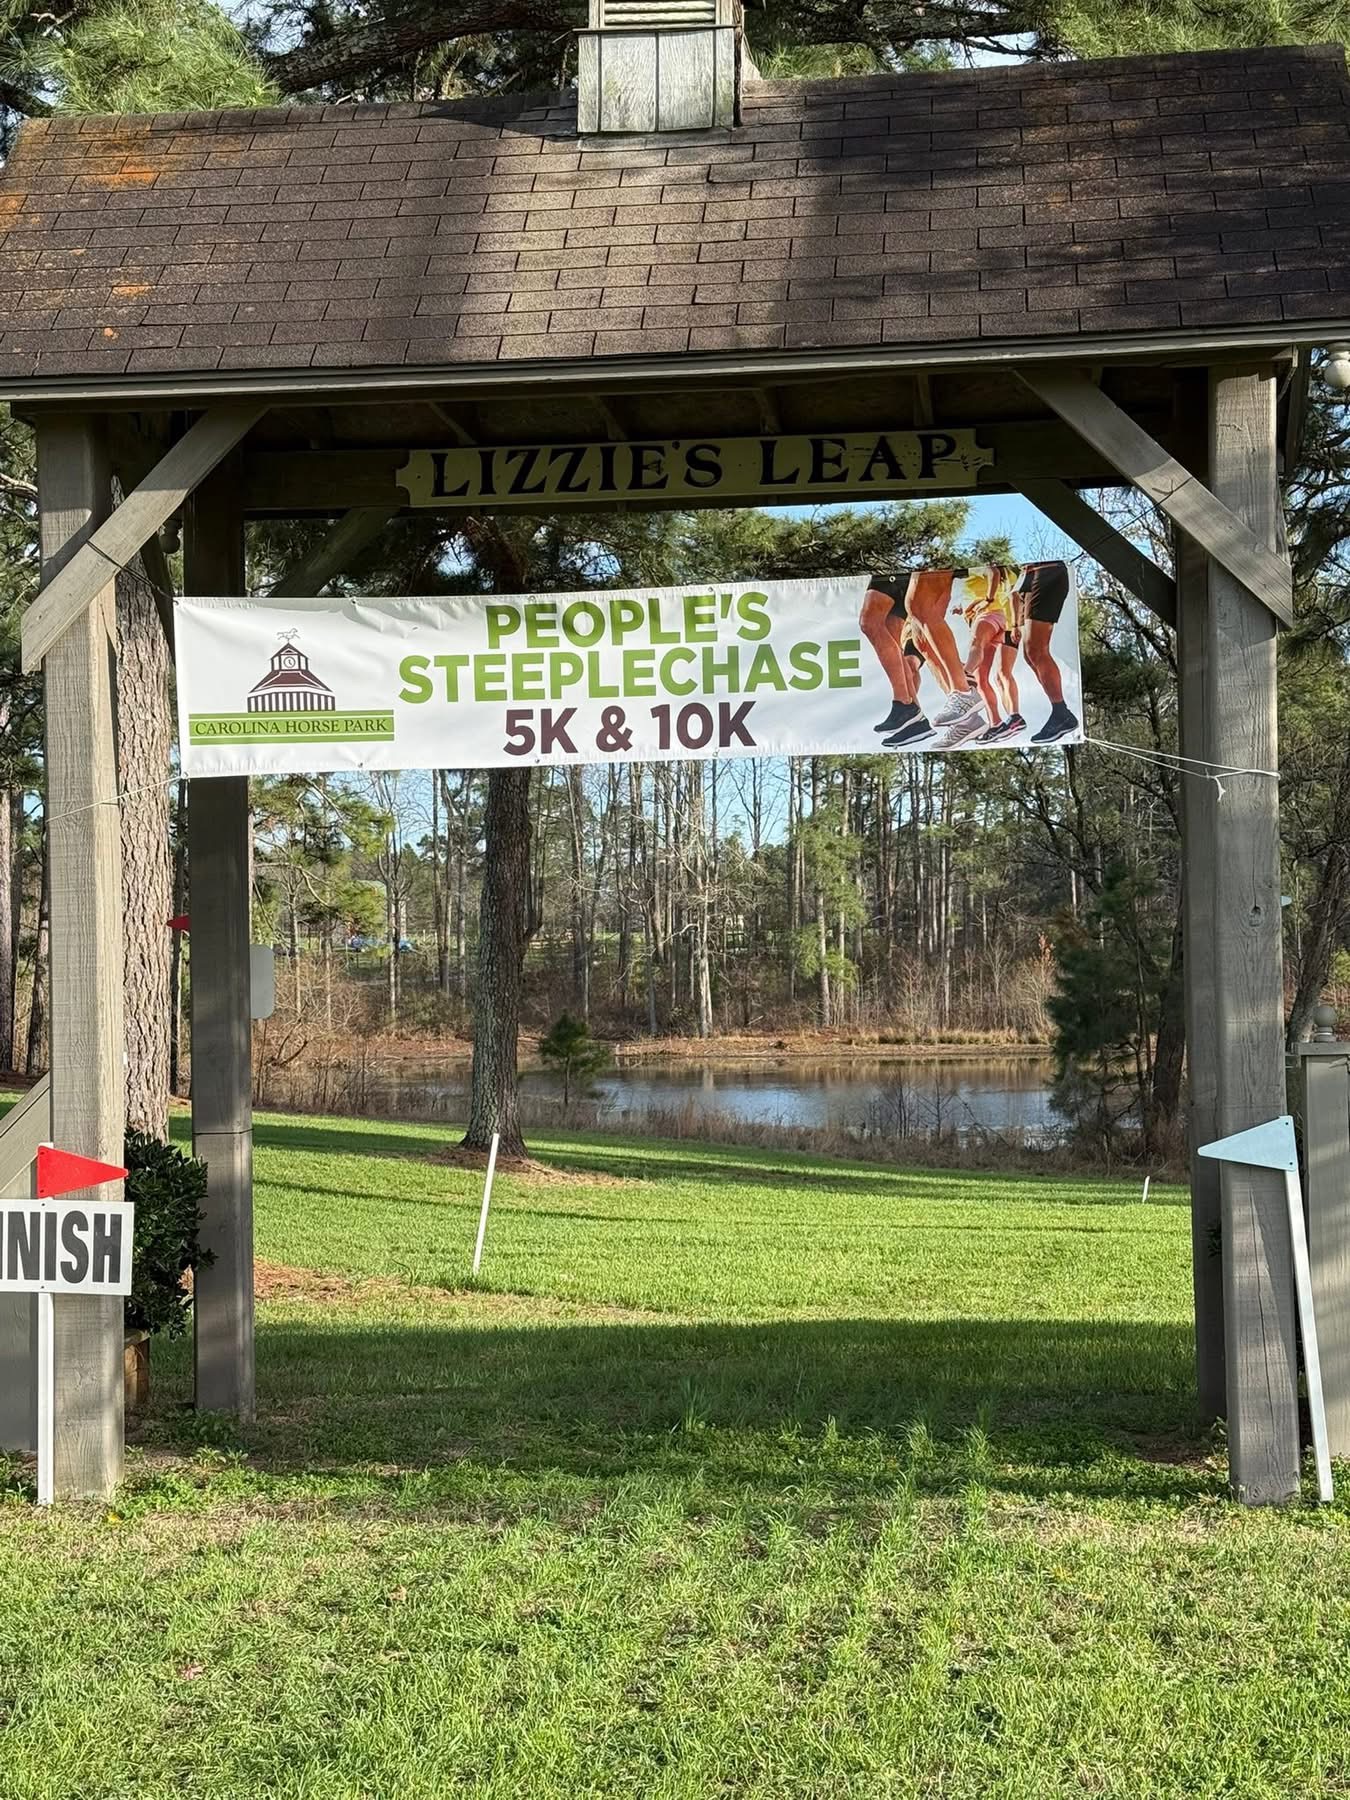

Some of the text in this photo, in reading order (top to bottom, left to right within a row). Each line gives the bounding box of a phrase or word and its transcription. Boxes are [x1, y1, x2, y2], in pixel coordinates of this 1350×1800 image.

[431, 433, 957, 498] LIZZIE'S LEAP
[485, 591, 771, 650] PEOPLE'S
[398, 640, 862, 704] STEEPLECHASE
[195, 718, 388, 735] CAROLINA HORSE PARK
[503, 700, 757, 756] 5K & 10K
[0, 1210, 122, 1284] NISH
